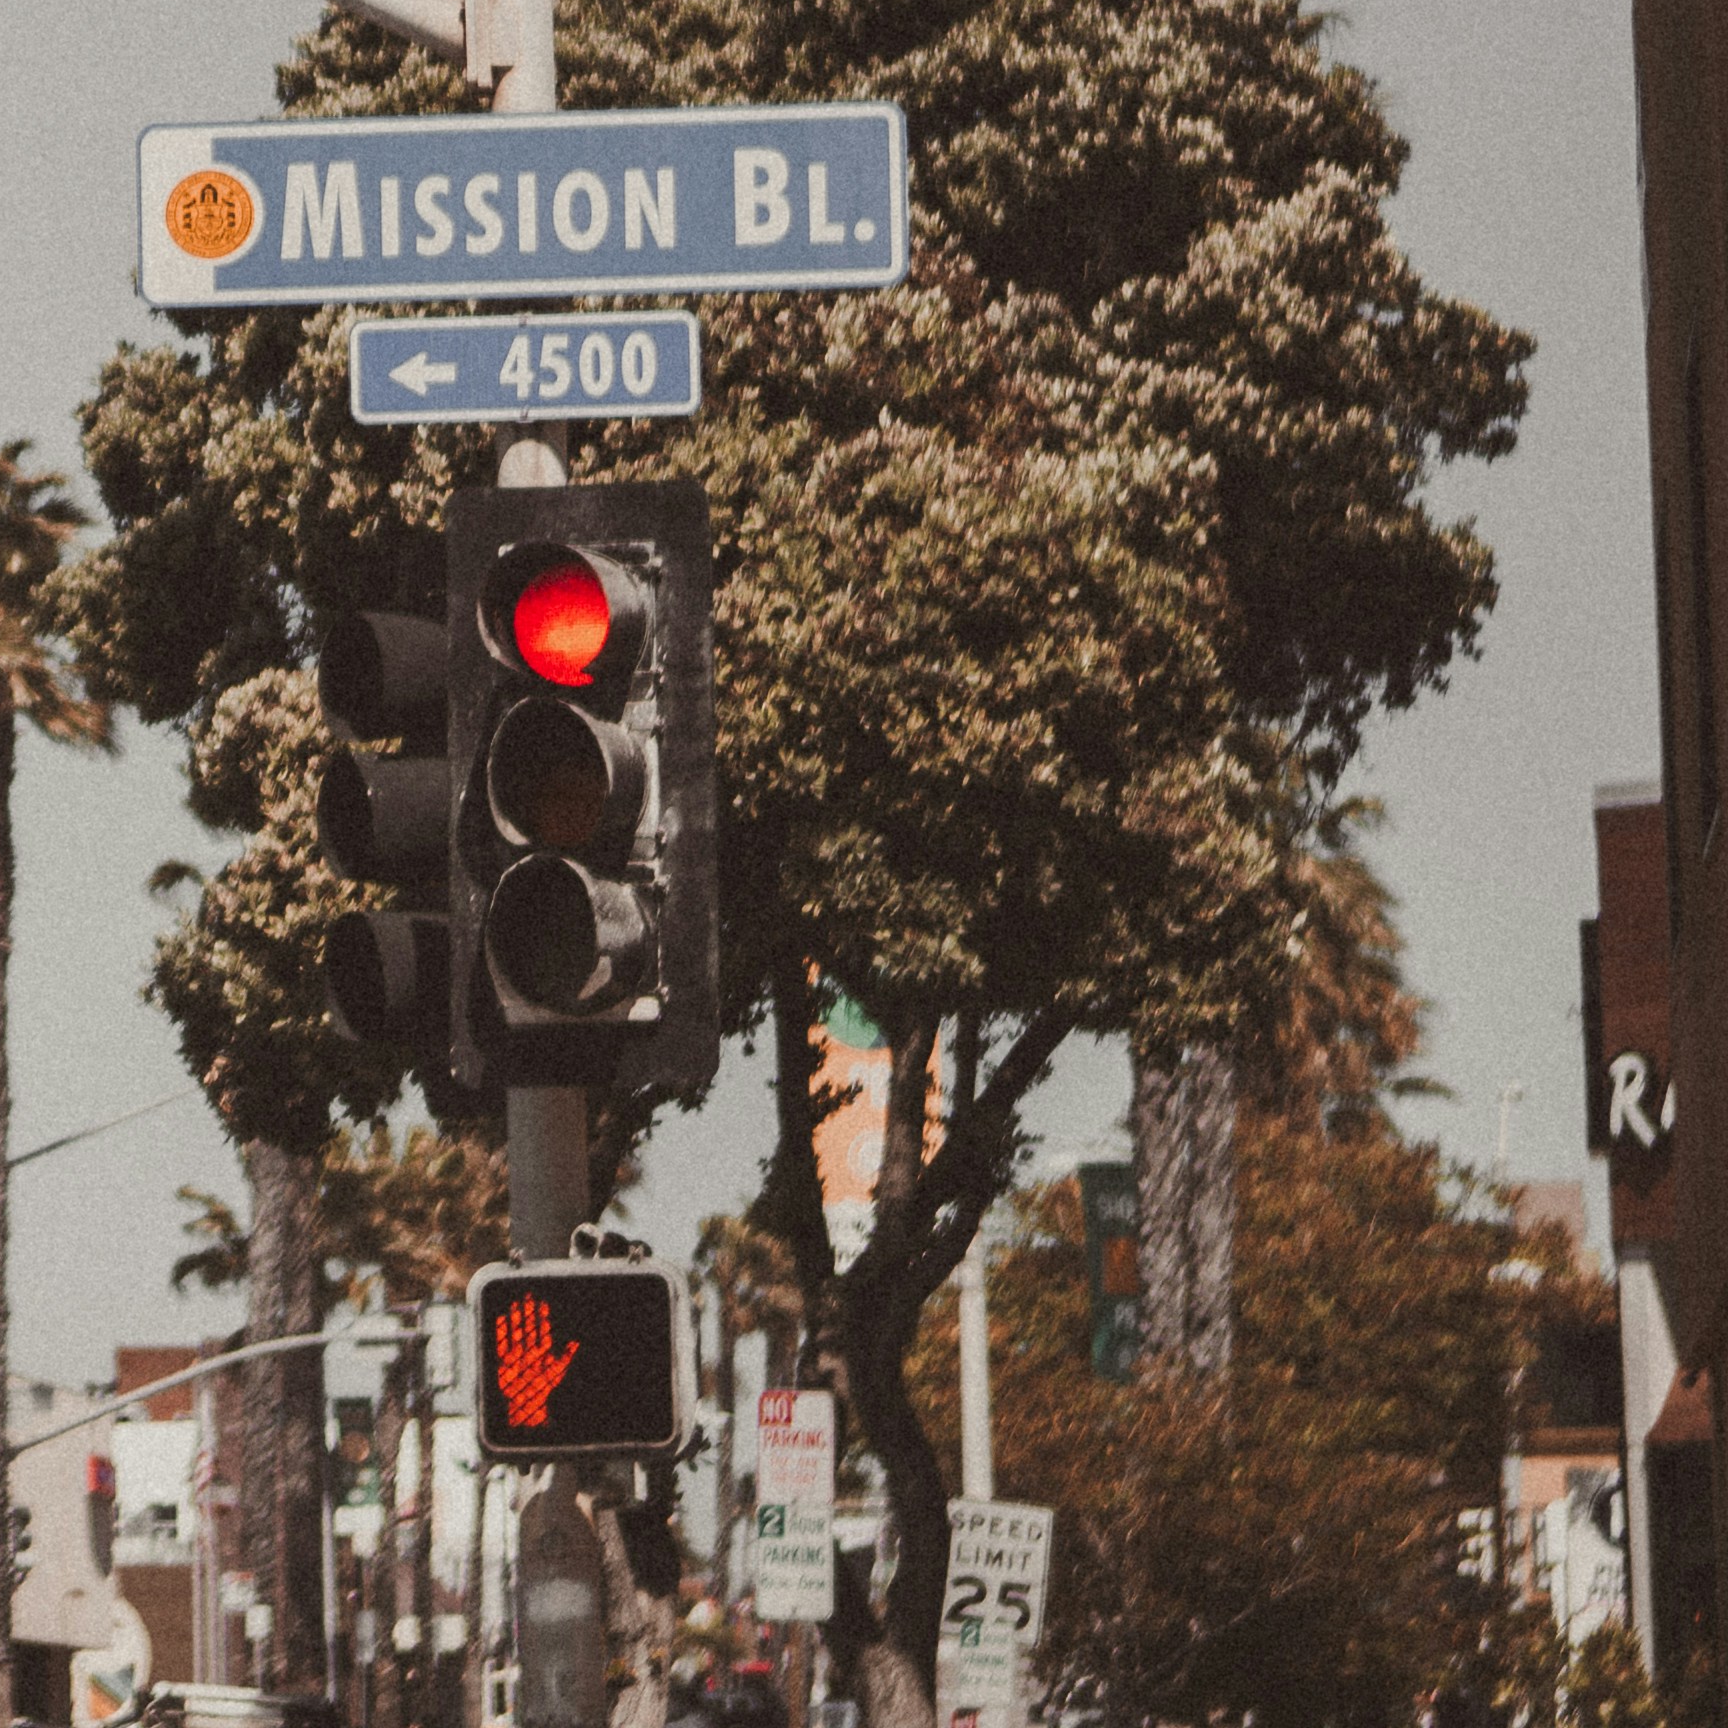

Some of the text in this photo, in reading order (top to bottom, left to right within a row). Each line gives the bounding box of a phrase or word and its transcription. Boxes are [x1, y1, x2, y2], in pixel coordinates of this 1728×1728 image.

[280, 159, 678, 264] MISSION
[733, 147, 876, 247] BL.
[499, 331, 659, 400] 4500
[1608, 1051, 1676, 1148] R
[762, 1506, 781, 1535] 2
[950, 1510, 1043, 1543] SPEED
[955, 1539, 1032, 1571] LIMIT
[945, 1575, 1032, 1630] 25
